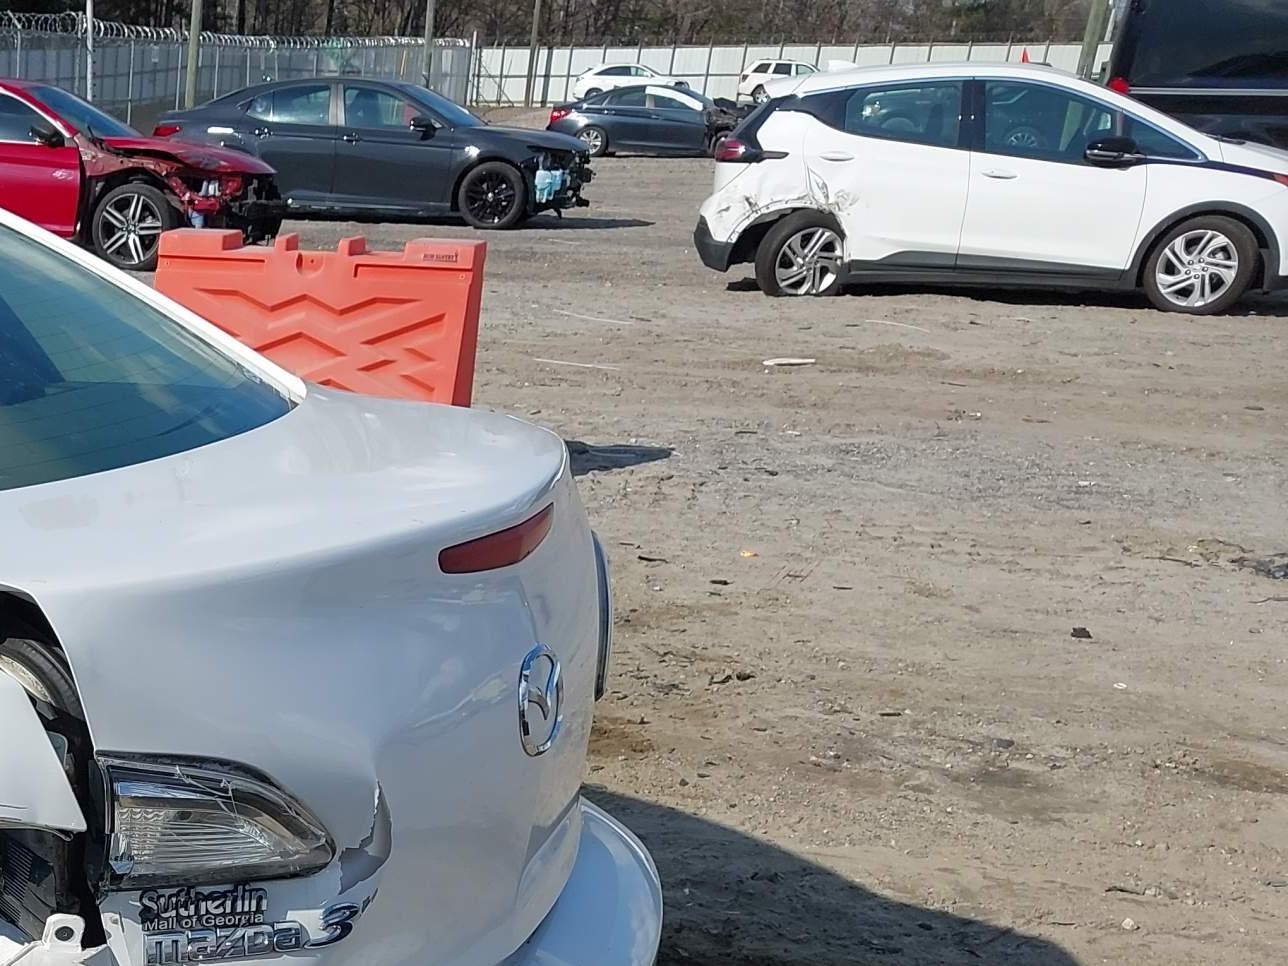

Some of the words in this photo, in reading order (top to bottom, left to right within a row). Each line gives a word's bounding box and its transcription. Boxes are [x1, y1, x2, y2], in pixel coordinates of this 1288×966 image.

[140, 884, 267, 918] Sutherlin
[144, 918, 177, 931] Mall
[182, 915, 198, 928] of
[203, 911, 264, 927] Georgia
